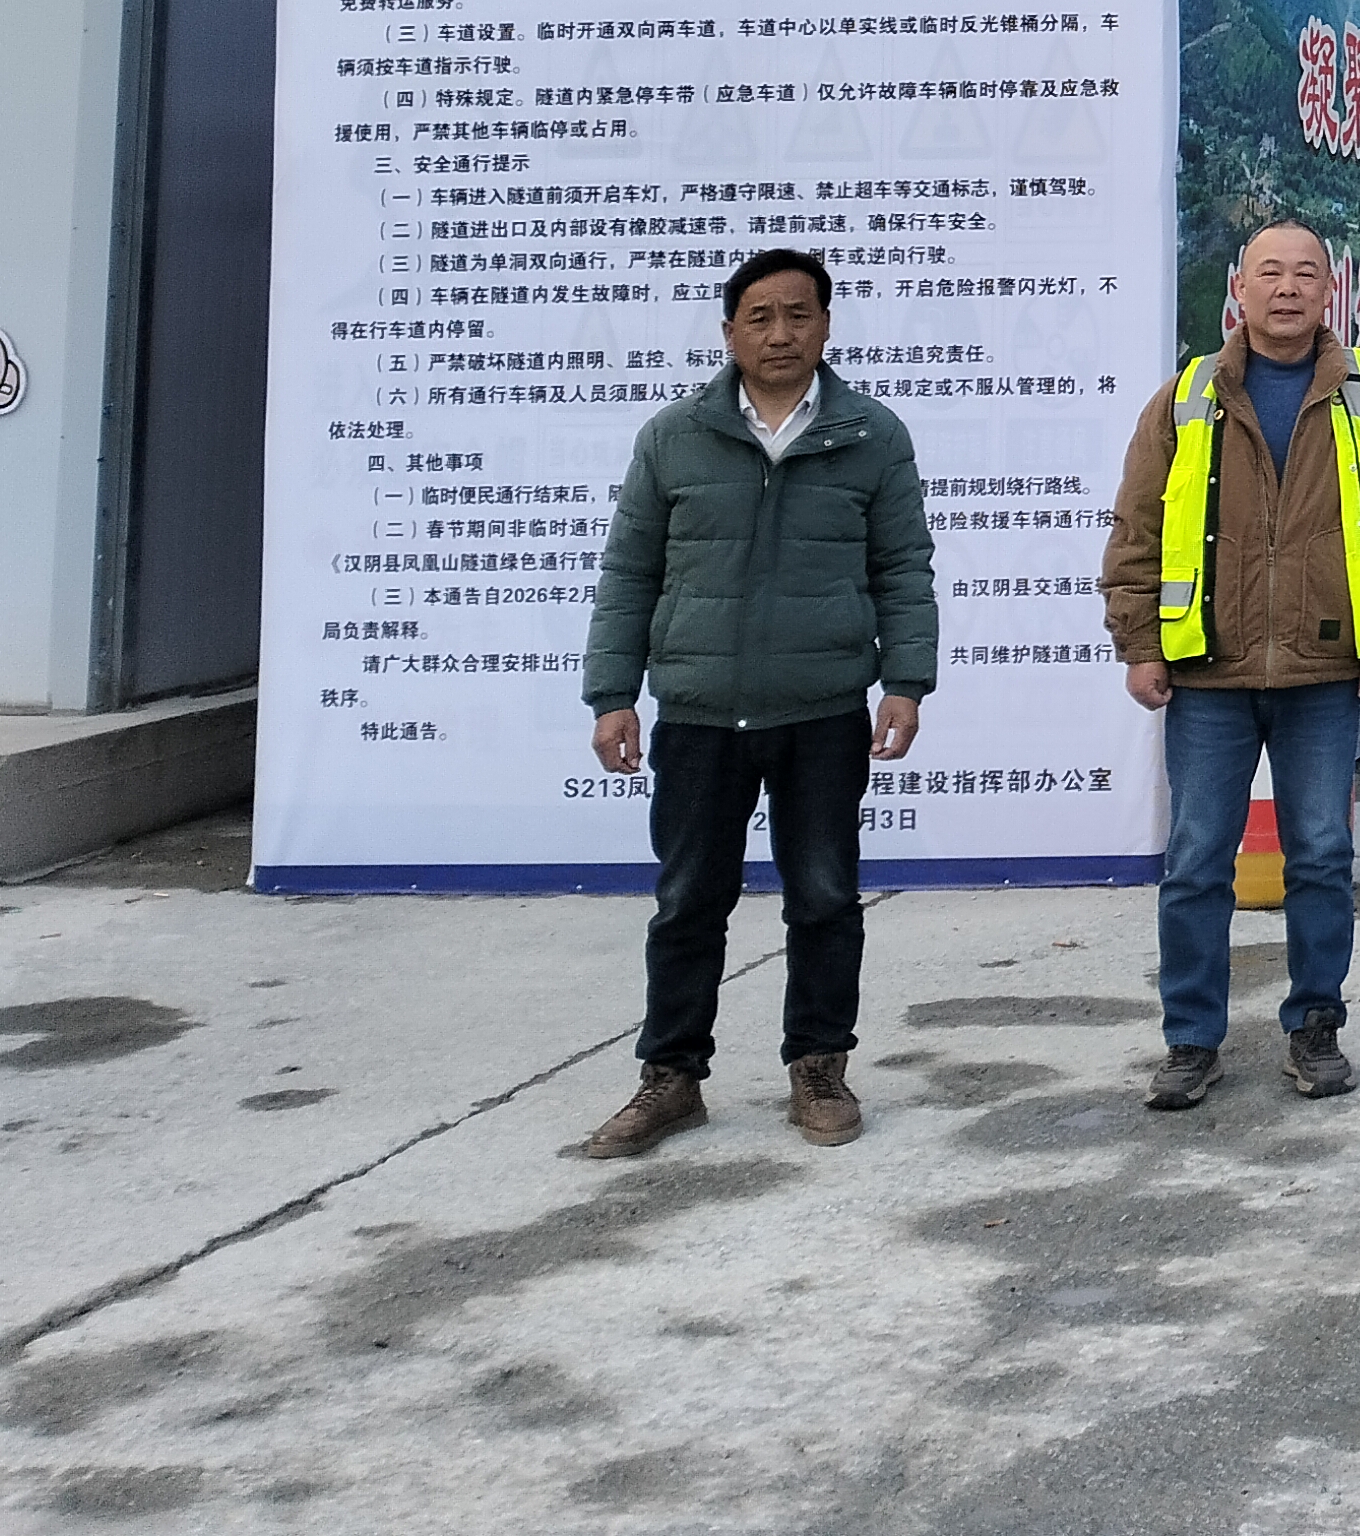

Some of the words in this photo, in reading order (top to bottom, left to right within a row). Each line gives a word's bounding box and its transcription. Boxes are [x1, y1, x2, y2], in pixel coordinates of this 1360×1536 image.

[336, 55, 519, 77] 辆须按车道指示行驶。
[334, 118, 638, 143] 援使用，严禁其他车辆临停或占用。
[373, 153, 531, 174] 三、安全通行提示
[330, 319, 495, 341] 得在行车道内停留。
[328, 420, 415, 440] 依法处理。
[368, 452, 484, 473] 四、其他事项
[331, 551, 606, 574] 《汉阴县凤凰山隧道绿色通行管
[322, 620, 429, 641] 局负责解释。
[362, 653, 587, 674] 请广大群众合理安排出行
[320, 688, 369, 708] 秩序。
[360, 721, 448, 741] 特此通告。
